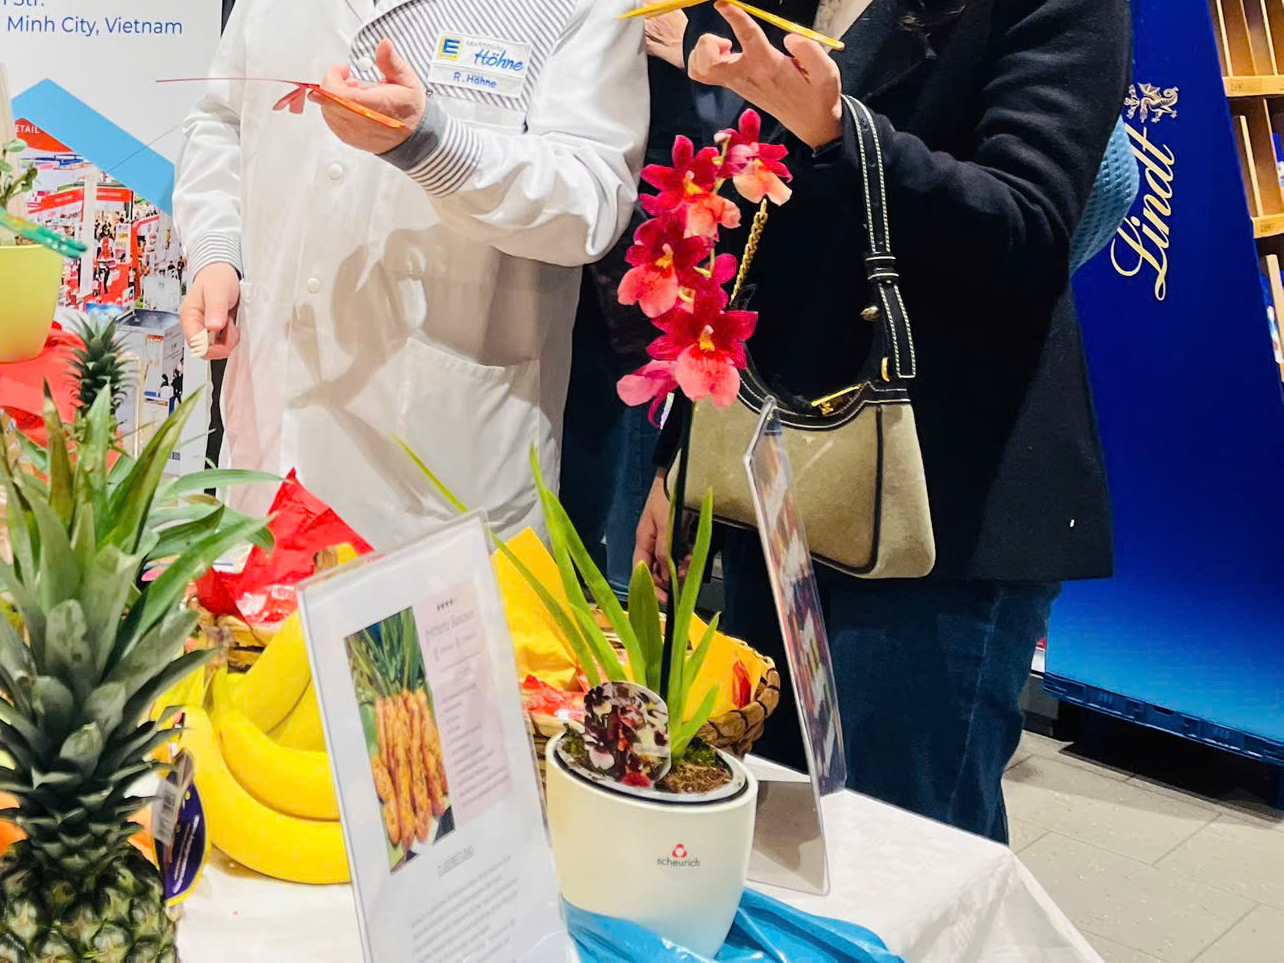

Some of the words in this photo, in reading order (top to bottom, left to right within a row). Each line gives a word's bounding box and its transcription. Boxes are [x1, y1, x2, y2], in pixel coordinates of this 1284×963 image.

[7, 15, 56, 33] Minh
[61, 16, 100, 37] City,
[104, 16, 183, 35] Vietnam
[473, 47, 525, 72] Höhne
[466, 72, 498, 89] Höhne
[14, 123, 41, 135] ETAIL
[1109, 122, 1176, 302] Lindt
[656, 855, 701, 868] scheurich
